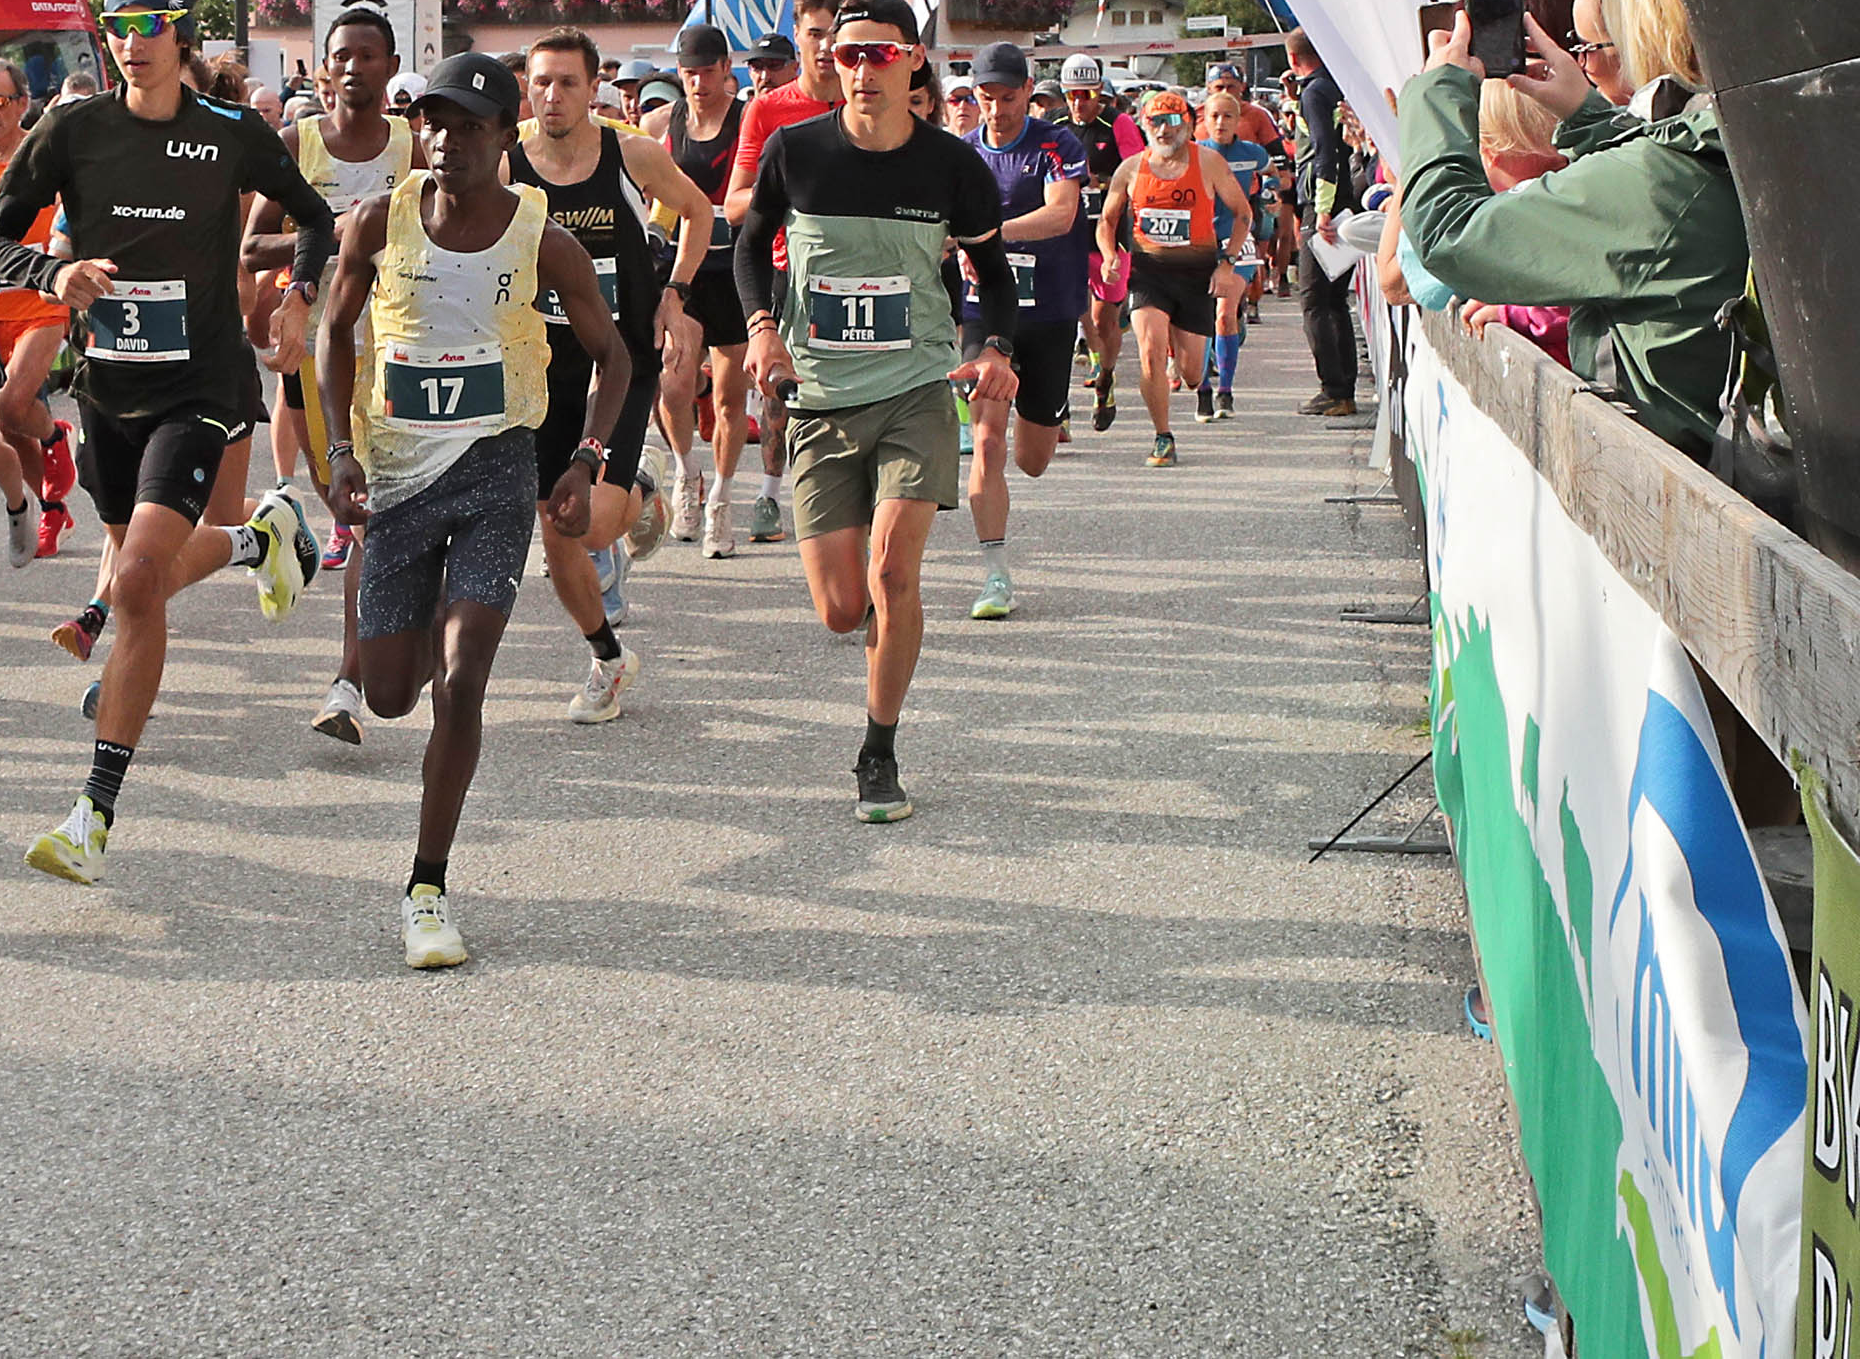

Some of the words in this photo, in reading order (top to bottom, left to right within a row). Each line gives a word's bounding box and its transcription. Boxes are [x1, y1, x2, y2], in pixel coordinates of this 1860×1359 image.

[166, 140, 219, 161] UYN
[111, 205, 186, 220] xc-run.de
[1149, 218, 1179, 235] 207
[122, 302, 141, 336] 3
[842, 297, 875, 328] 11
[116, 338, 149, 351] DAVID
[420, 378, 464, 414] 17
